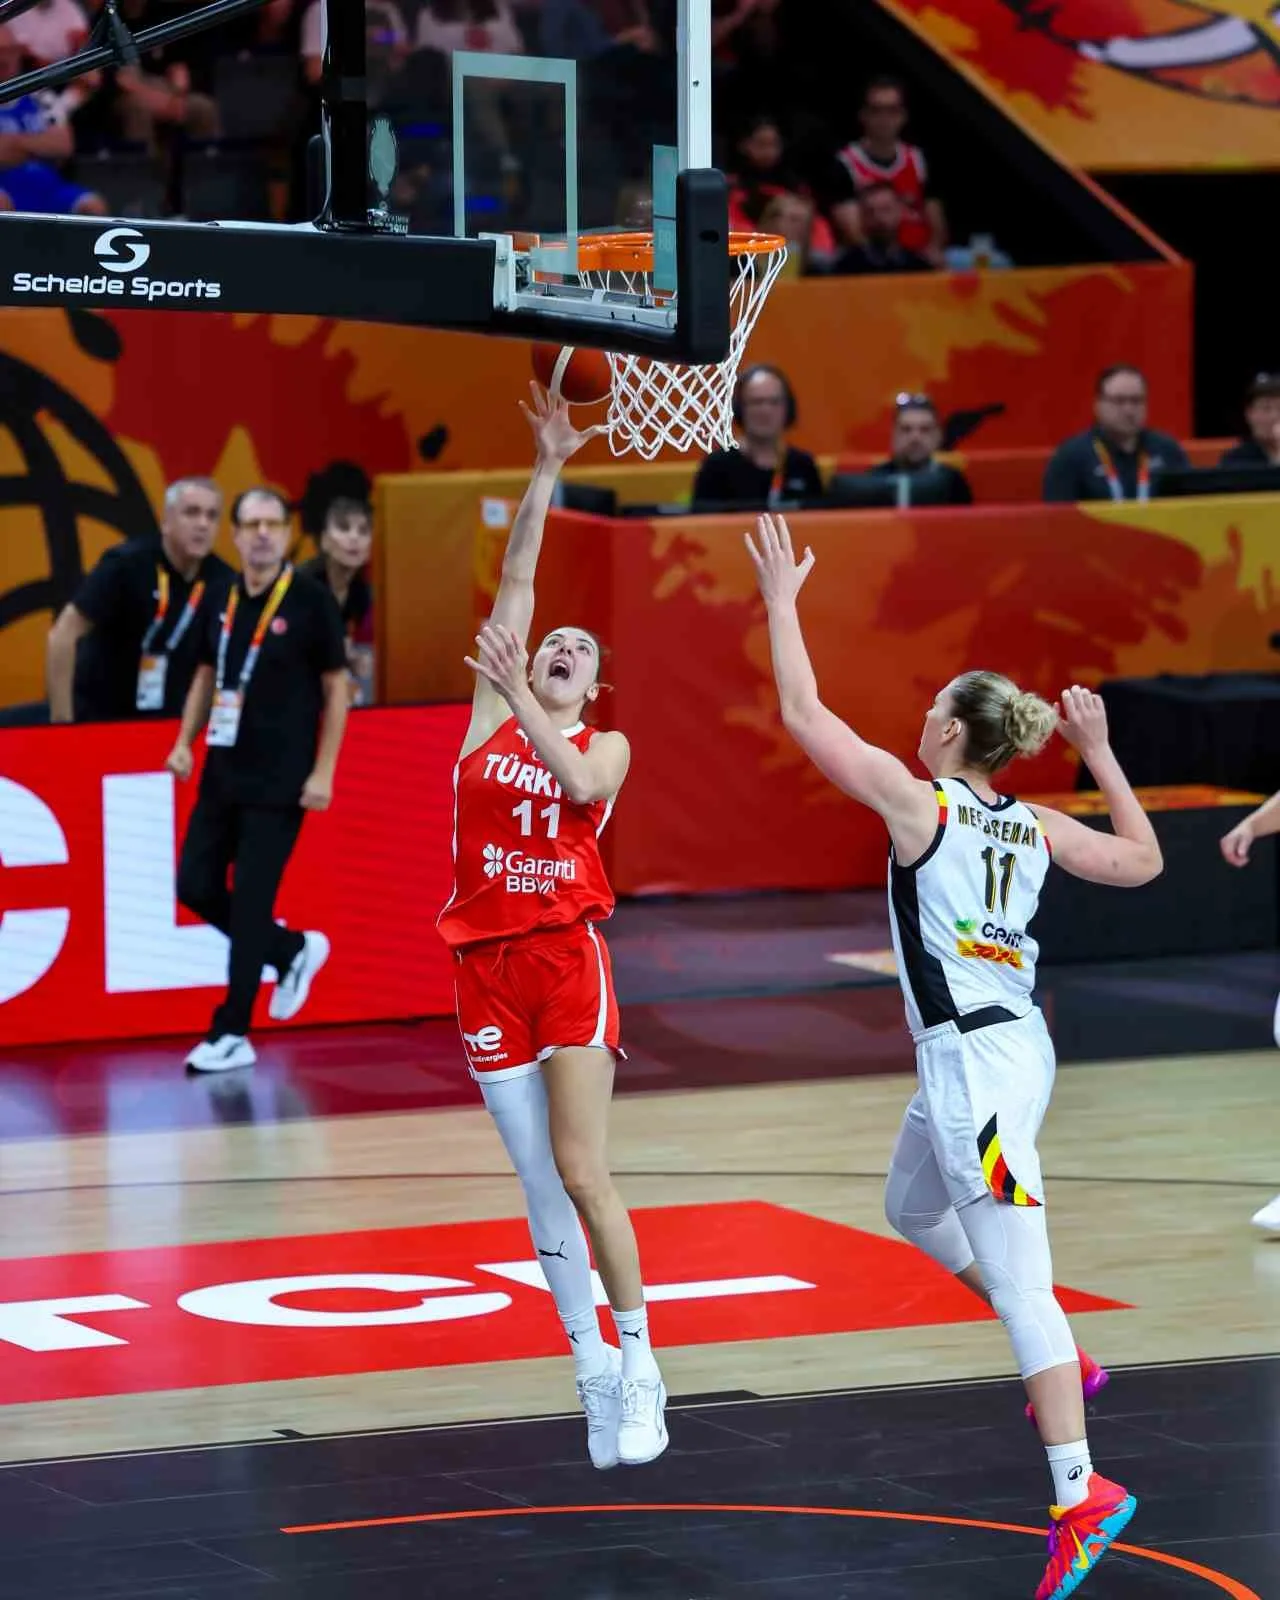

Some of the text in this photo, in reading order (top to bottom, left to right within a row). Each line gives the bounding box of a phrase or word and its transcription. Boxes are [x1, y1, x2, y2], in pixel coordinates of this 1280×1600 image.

[12, 273, 222, 302] Schelde Sports
[512, 799, 561, 839] 11
[505, 851, 577, 880] Garanti
[981, 846, 1017, 918] 11
